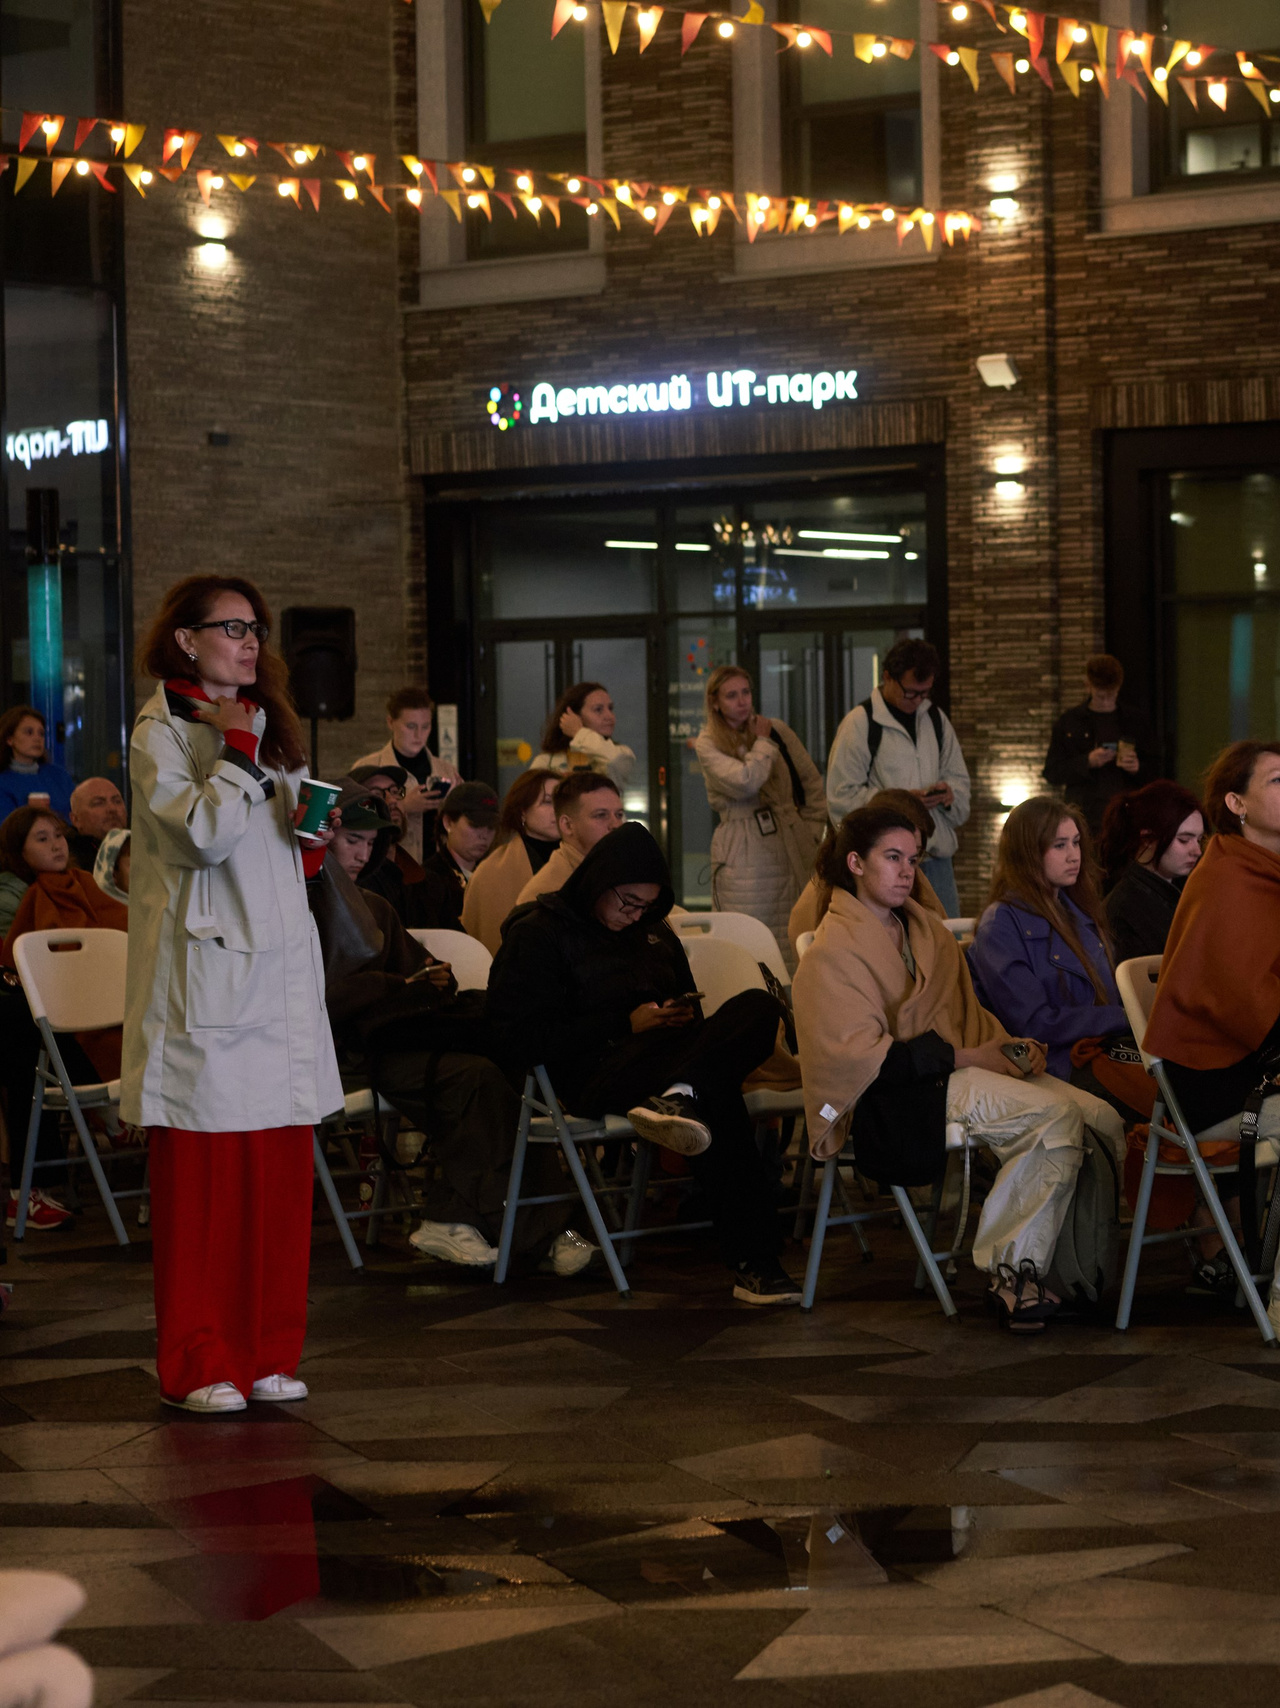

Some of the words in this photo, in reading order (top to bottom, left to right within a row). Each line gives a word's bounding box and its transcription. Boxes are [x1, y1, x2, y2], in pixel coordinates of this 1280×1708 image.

[530, 374, 692, 424] Детский
[706, 369, 859, 410] ИТ-парк
[1120, 1052, 1141, 1062] OLO
